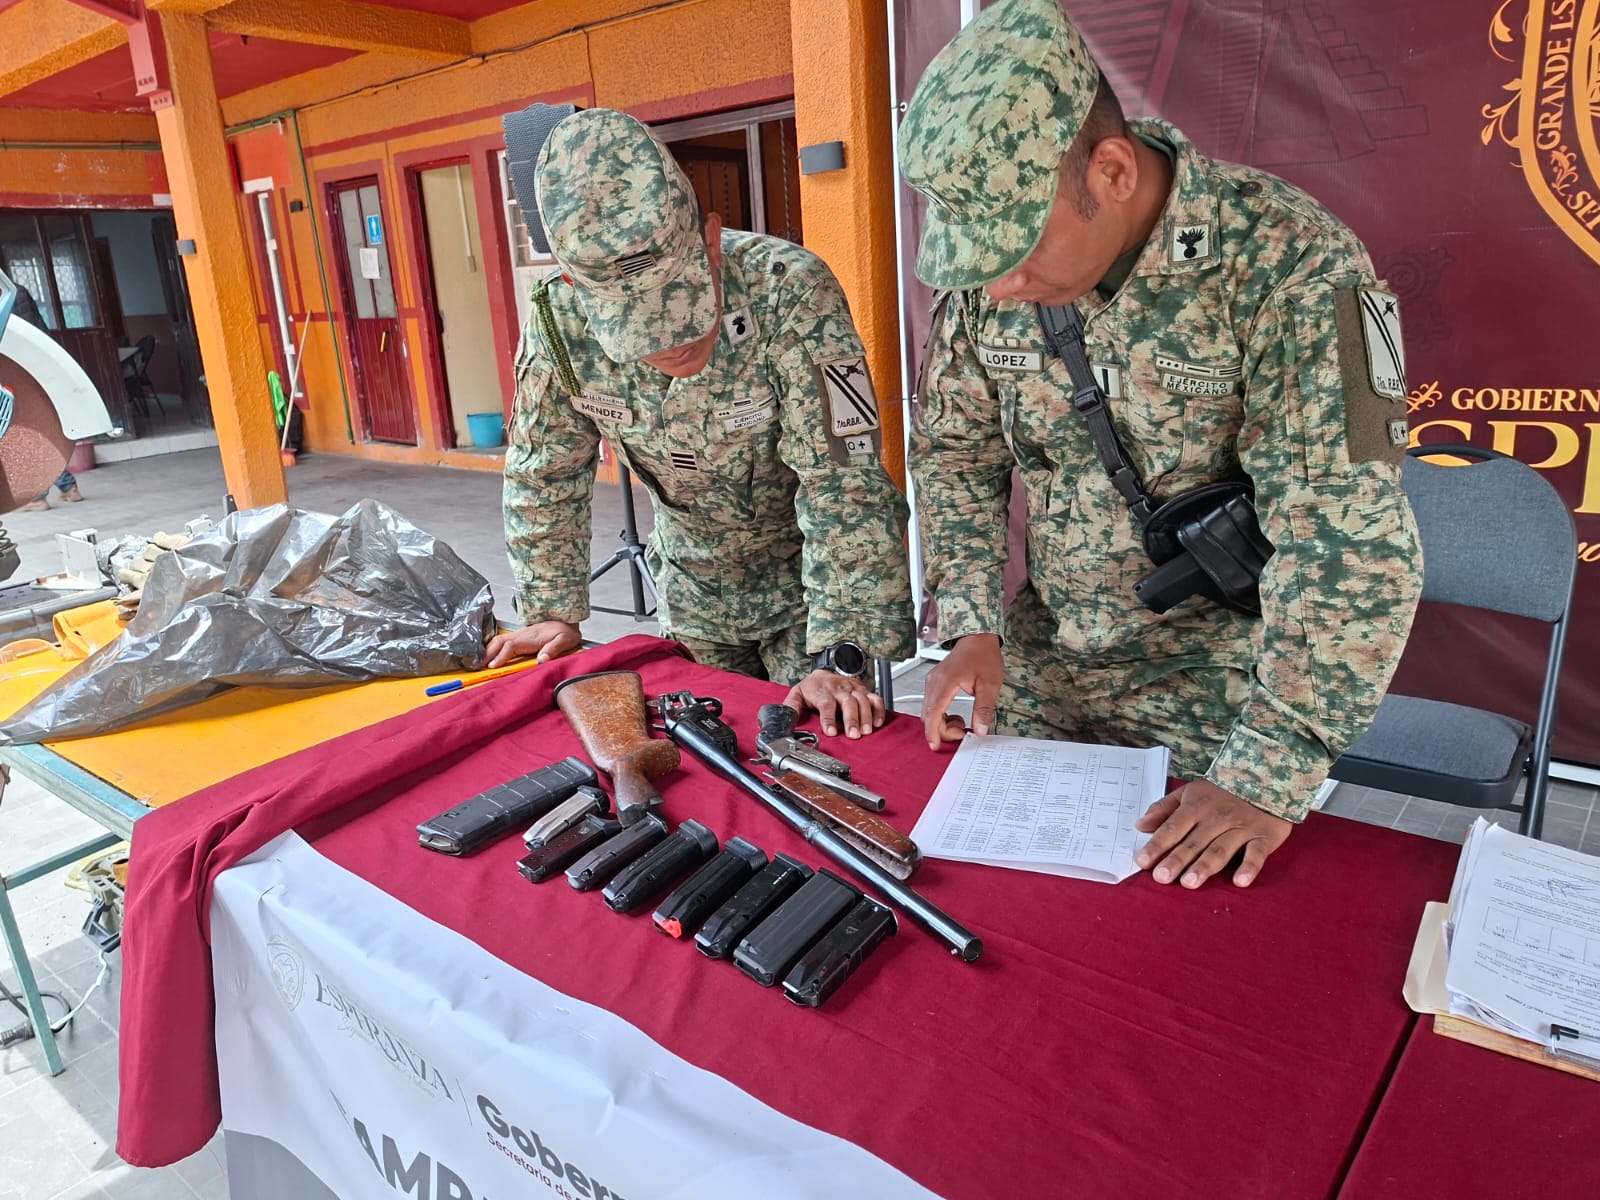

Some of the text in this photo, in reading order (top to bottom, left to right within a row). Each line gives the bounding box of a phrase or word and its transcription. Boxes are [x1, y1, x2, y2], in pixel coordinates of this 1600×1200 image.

[1536, 38, 1571, 150] GRANDE
[985, 353, 1026, 367] LOPEZ
[1166, 382, 1228, 395] MEXICANO
[1451, 387, 1600, 412] GOBIERN
[581, 402, 623, 420] MENDEZ
